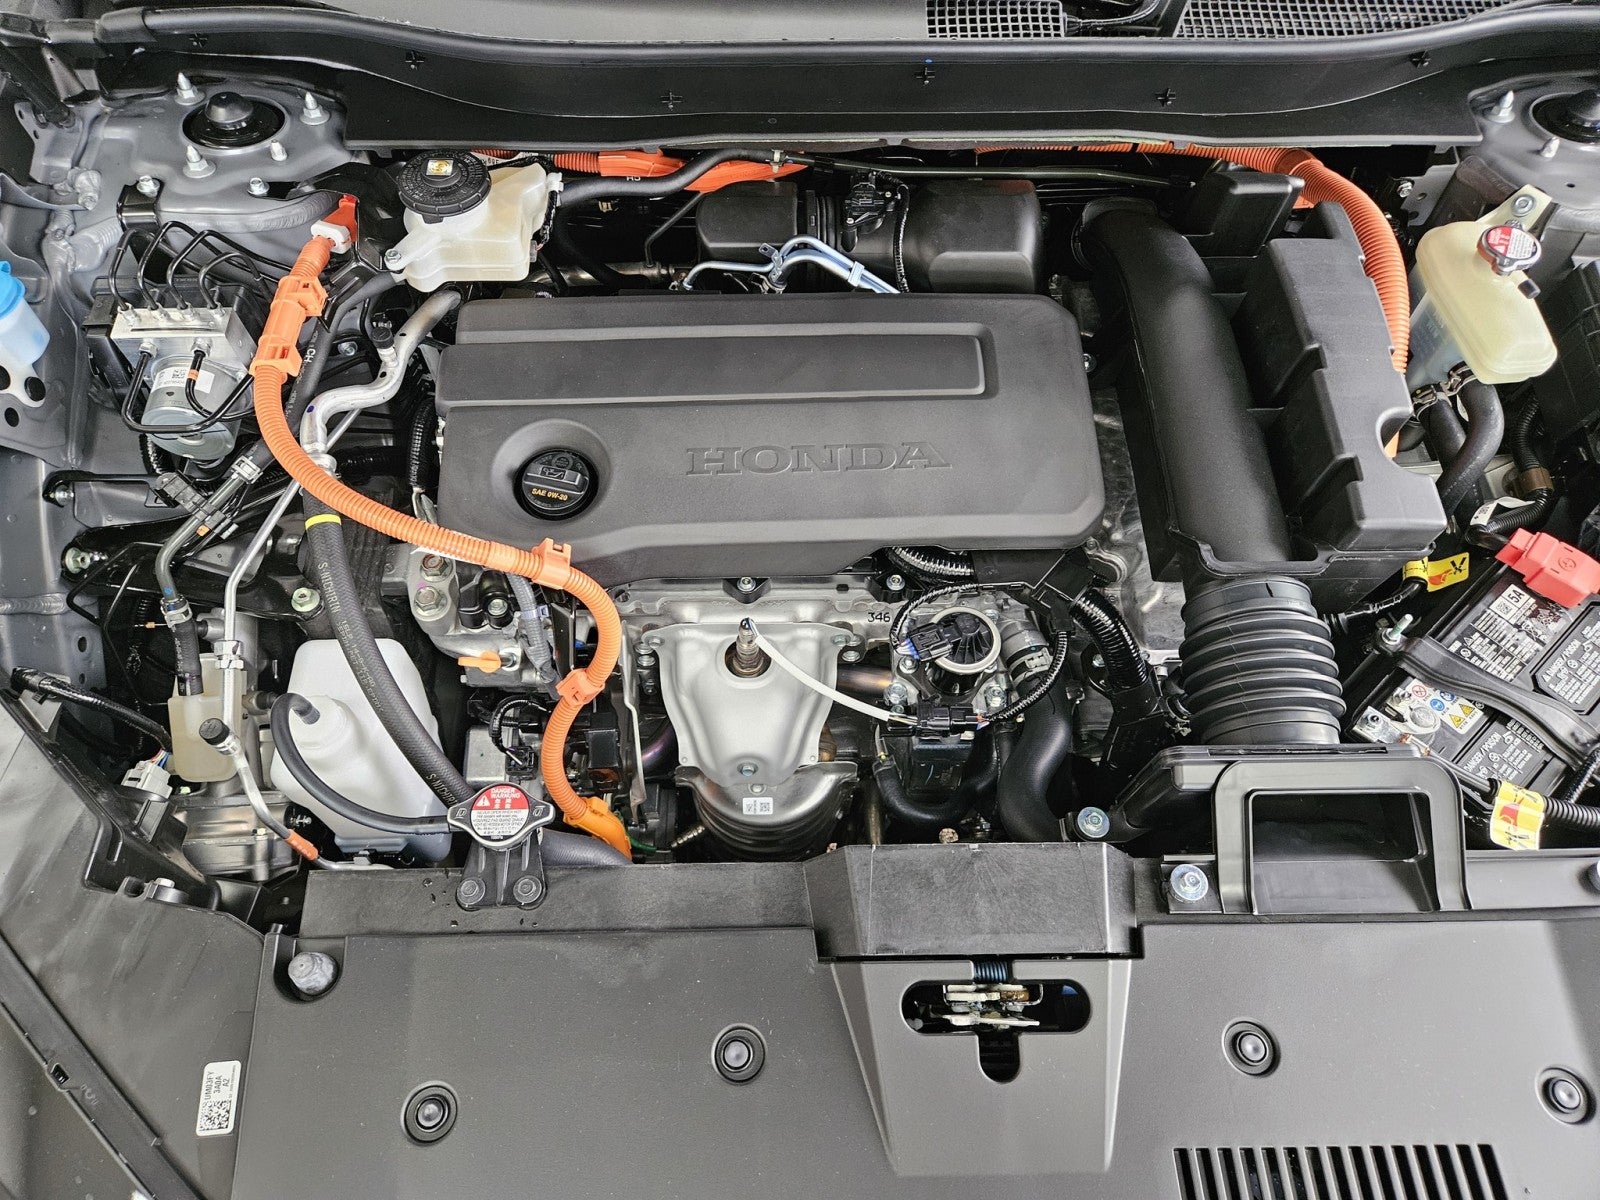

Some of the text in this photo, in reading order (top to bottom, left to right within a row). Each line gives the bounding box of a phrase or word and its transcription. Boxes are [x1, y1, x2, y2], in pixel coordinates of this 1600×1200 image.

[686, 442, 952, 476] HONDA
[531, 488, 547, 497] SAE
[547, 492, 568, 501] 0W-20
[1507, 589, 1525, 604] 5A
[867, 611, 891, 623] 346
[222, 1078, 230, 1087] A2
